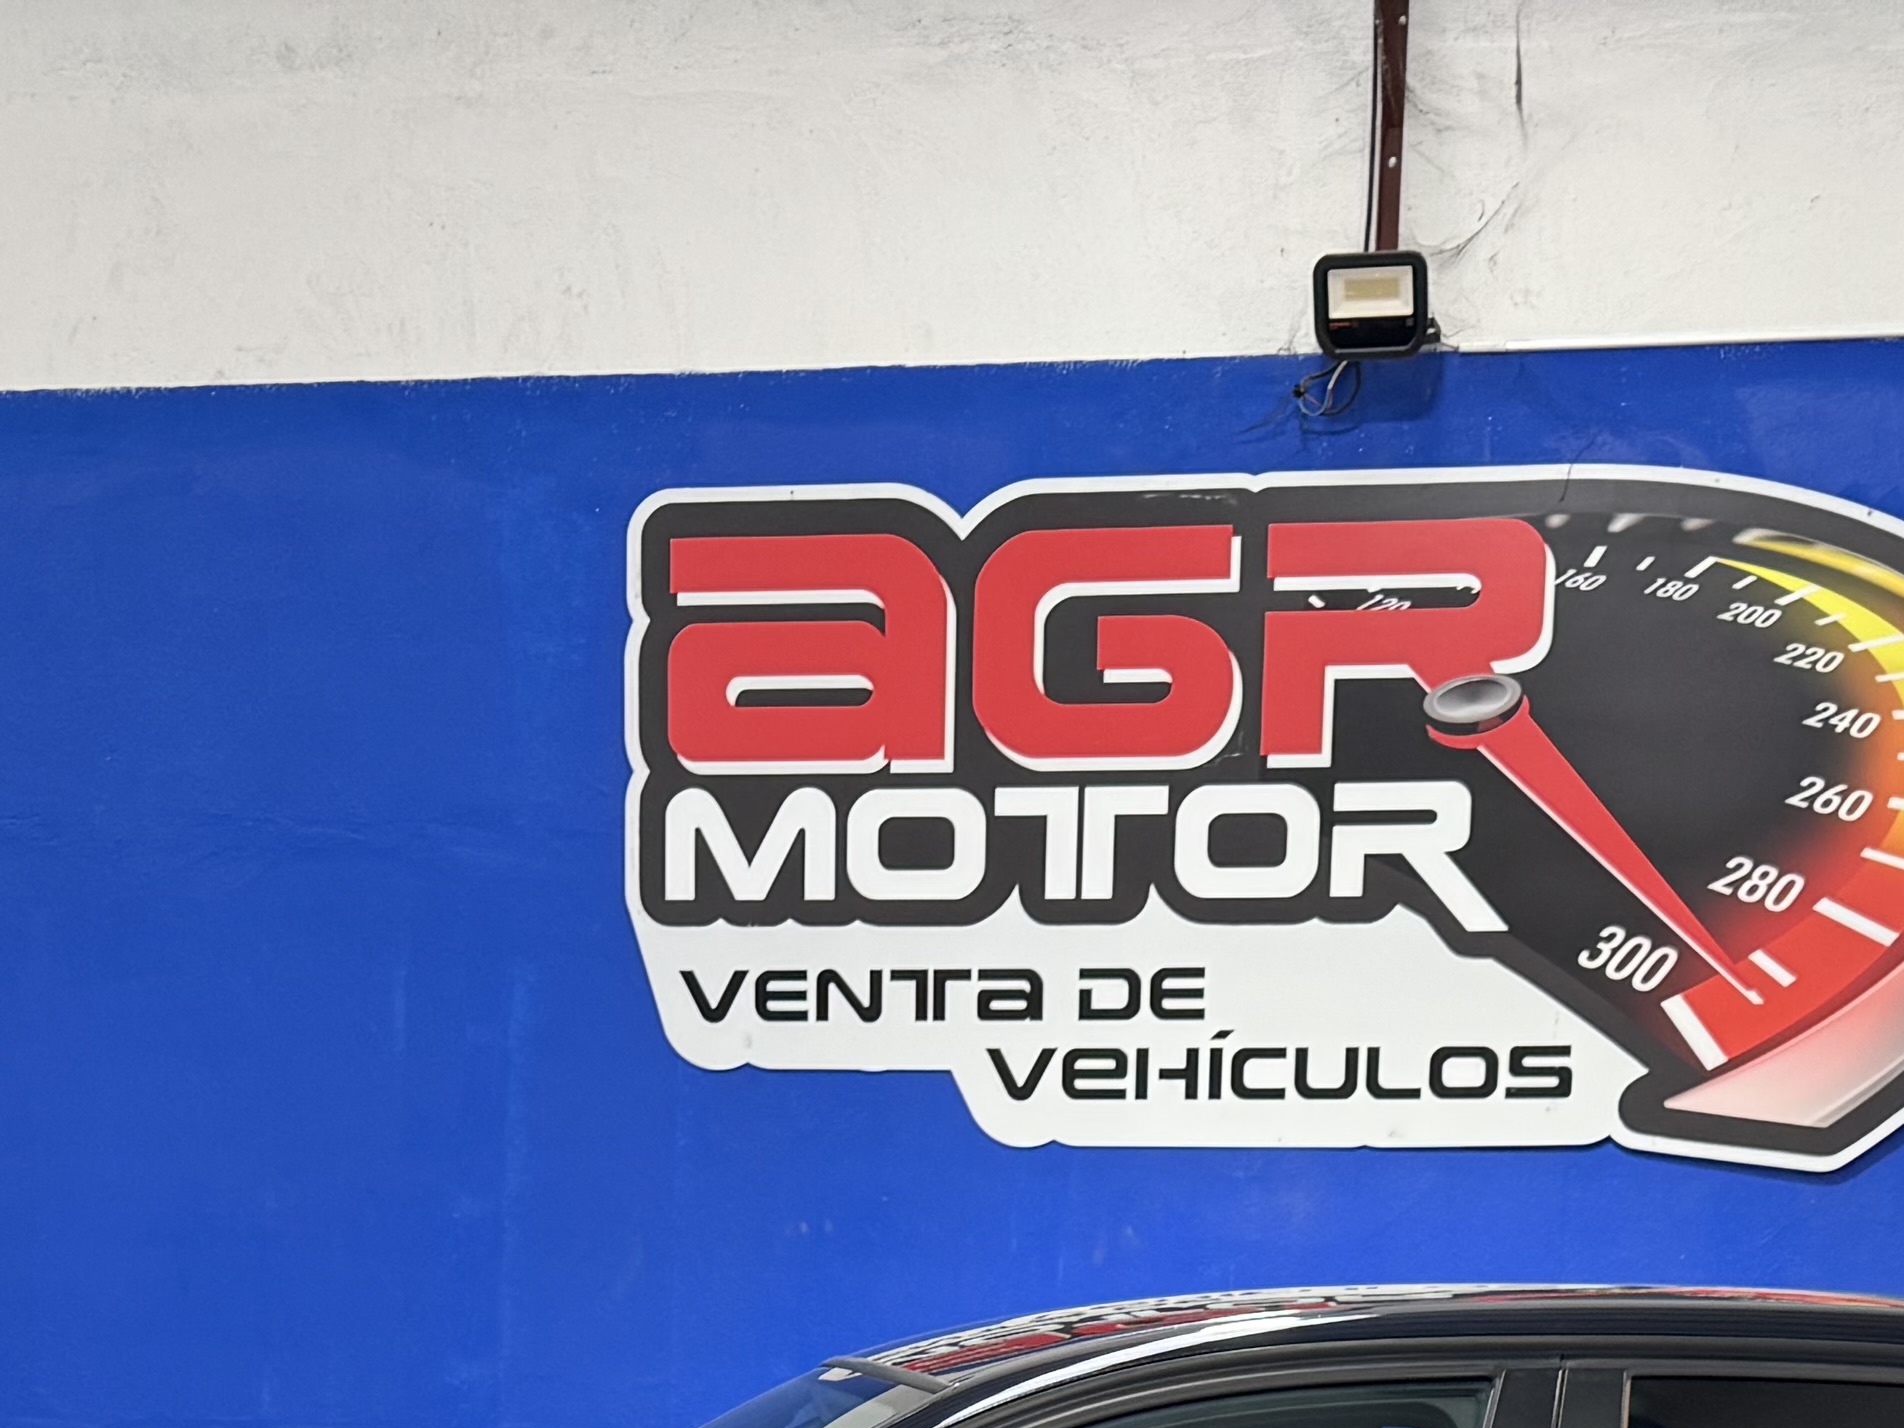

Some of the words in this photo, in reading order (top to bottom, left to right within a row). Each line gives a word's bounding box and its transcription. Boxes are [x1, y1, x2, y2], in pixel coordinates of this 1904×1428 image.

[1555, 569, 1607, 591] 160
[1643, 577, 1700, 601] 180
[1717, 602, 1782, 628] 200
[1773, 642, 1845, 674] 220
[1802, 702, 1881, 739] 240
[1784, 775, 1874, 822] 260
[664, 781, 1510, 932] MOTOR
[1707, 856, 1806, 912] 280
[1577, 925, 1679, 992] 300
[1077, 967, 1206, 1021] DE
